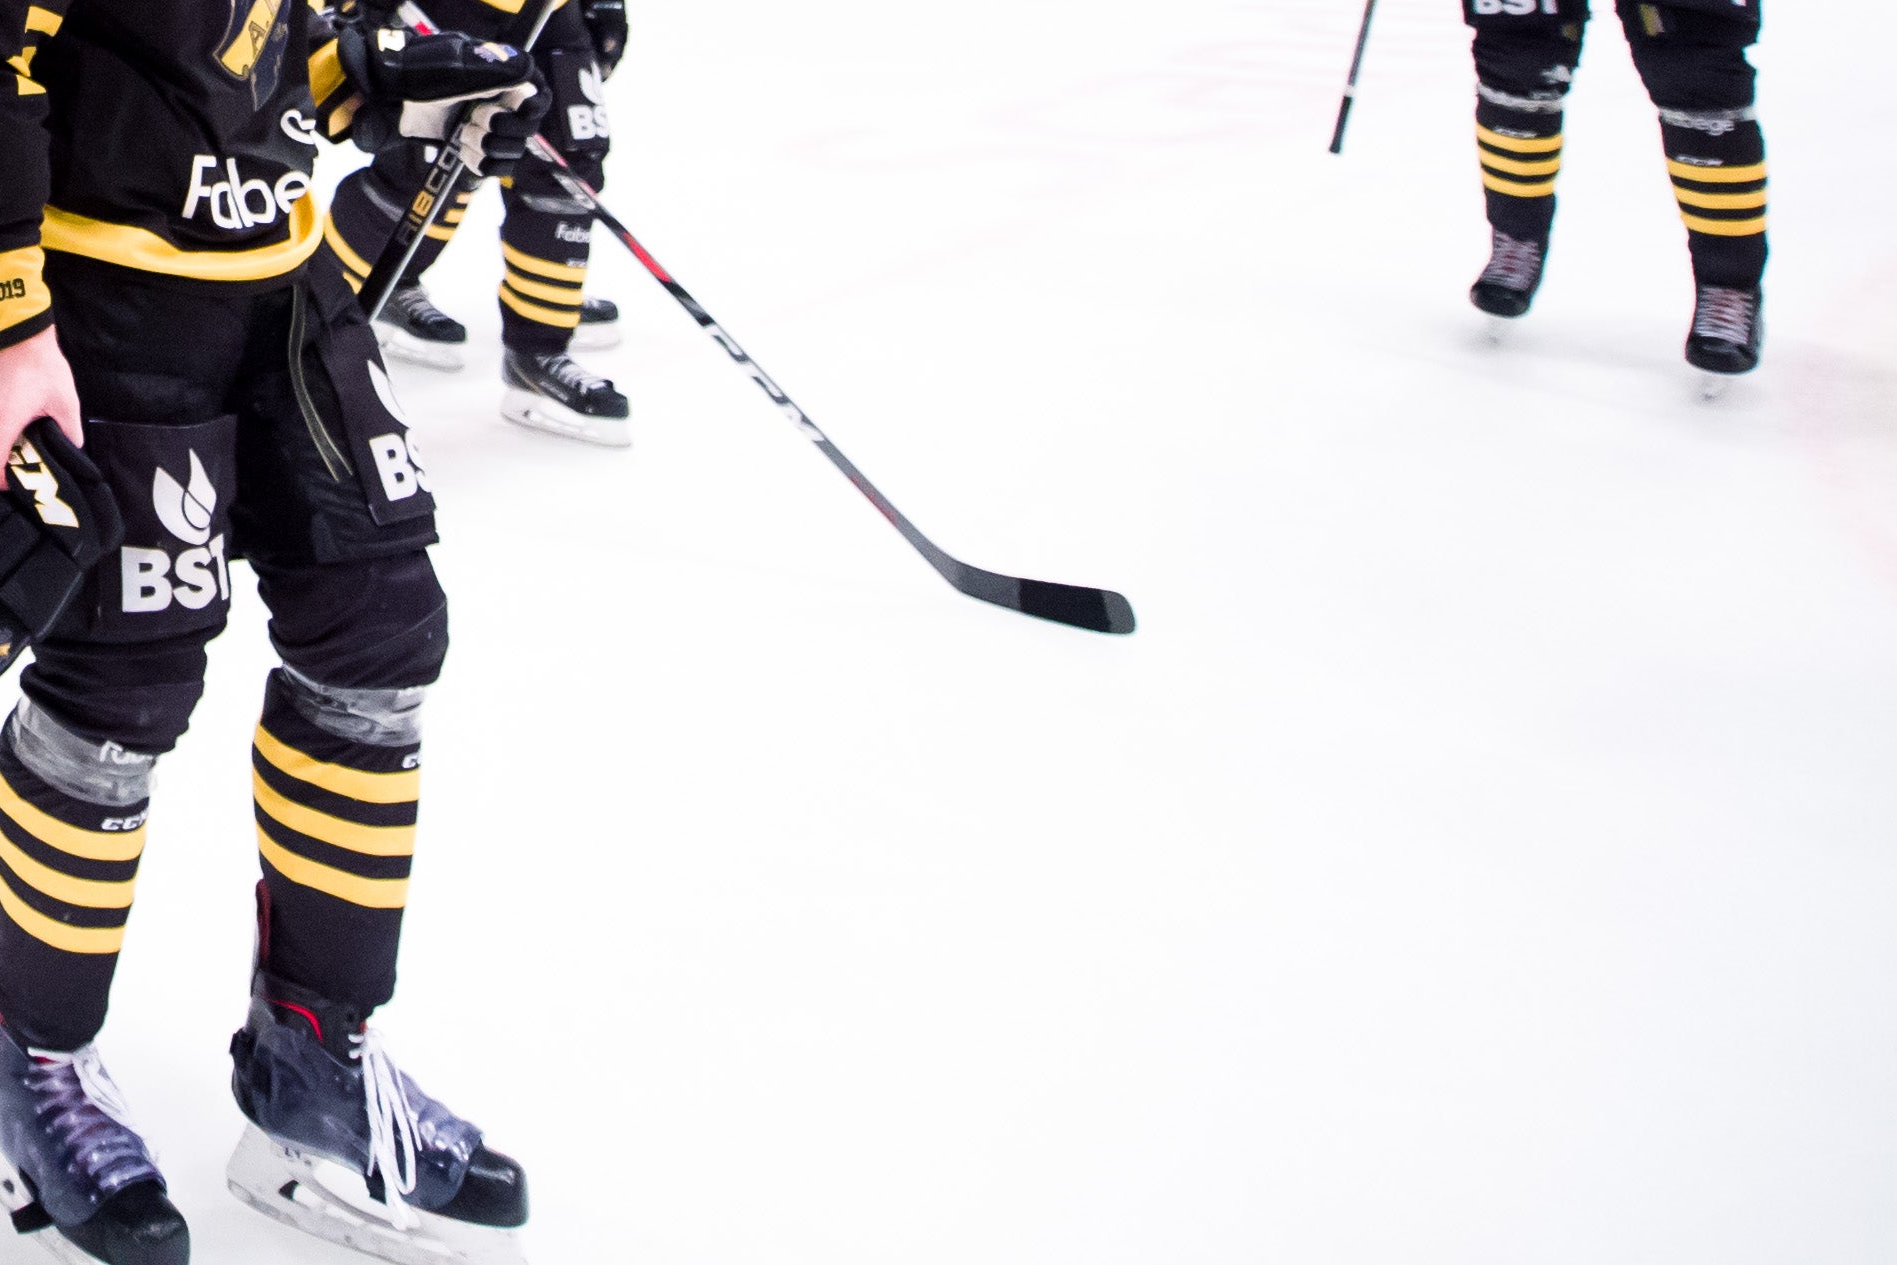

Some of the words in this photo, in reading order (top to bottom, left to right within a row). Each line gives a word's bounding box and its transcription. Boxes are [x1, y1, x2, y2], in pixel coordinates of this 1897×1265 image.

[568, 106, 610, 140] BS
[181, 154, 313, 229] Fabe
[368, 432, 432, 504] BS
[121, 534, 231, 614] BST
